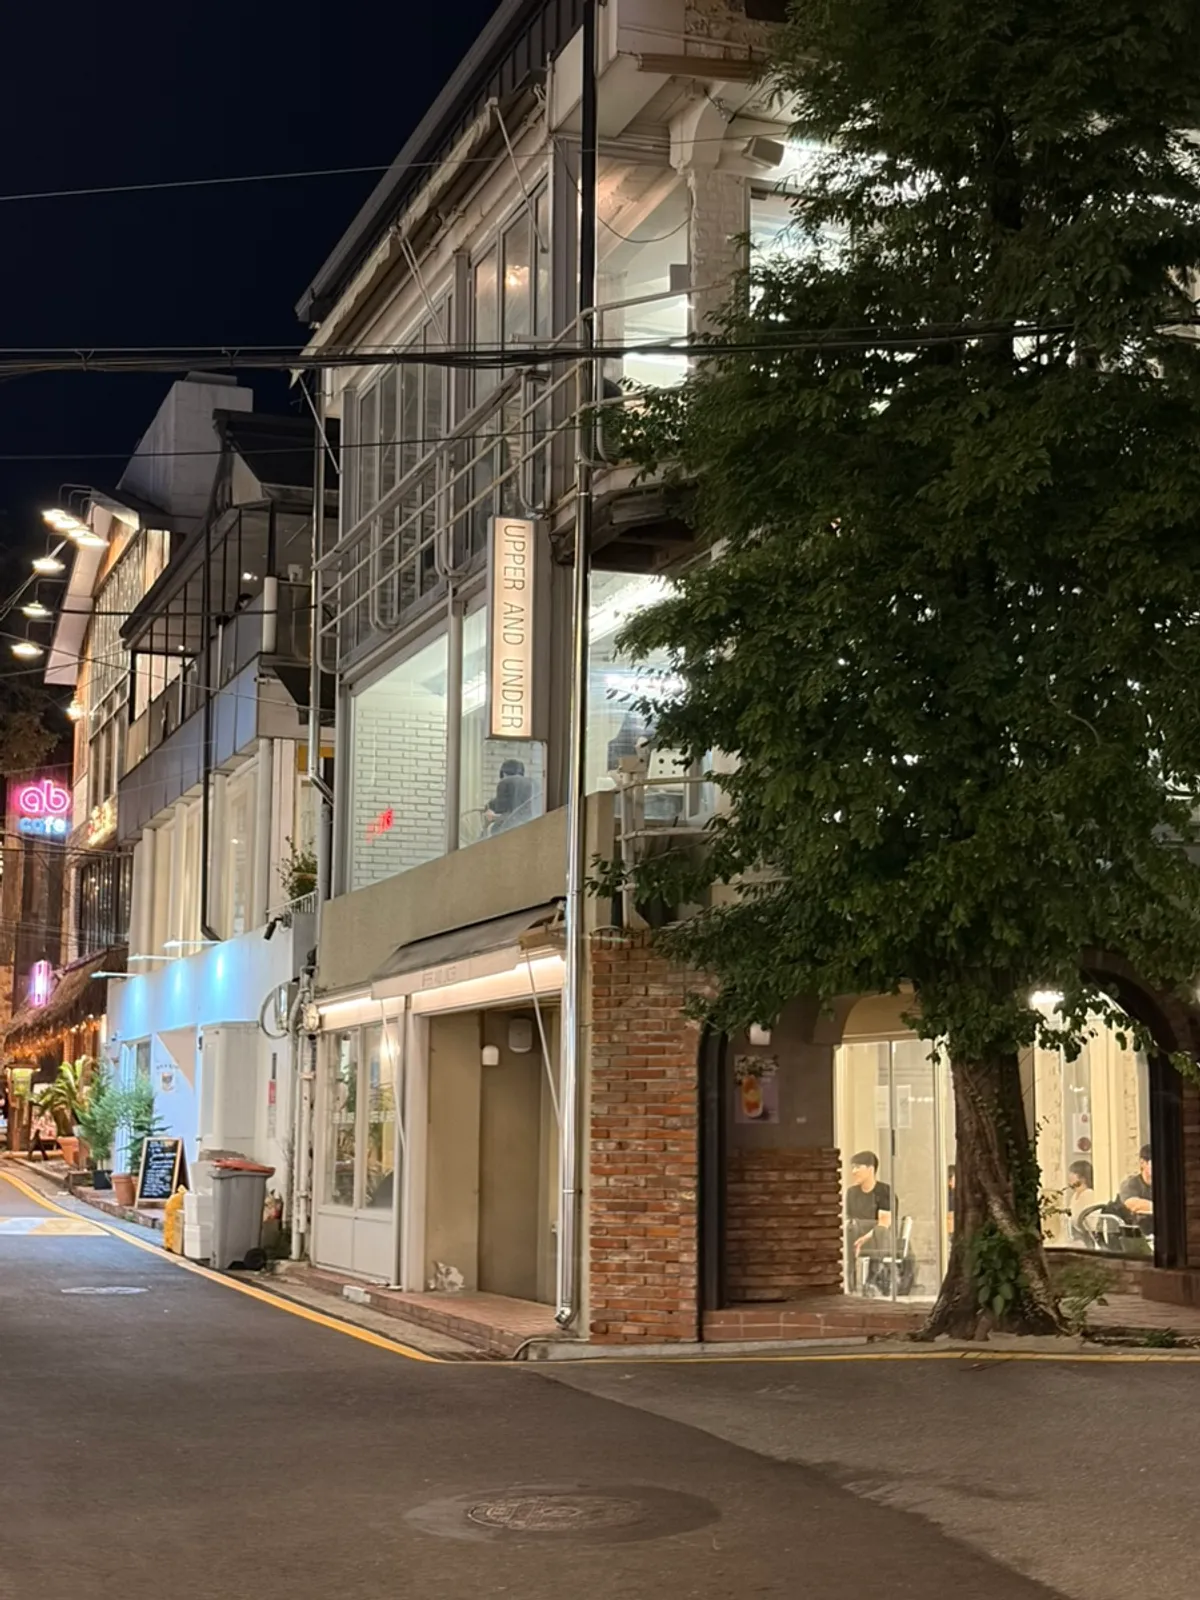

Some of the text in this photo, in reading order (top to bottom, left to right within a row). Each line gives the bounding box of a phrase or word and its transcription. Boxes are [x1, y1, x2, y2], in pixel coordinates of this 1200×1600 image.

[501, 524, 526, 729] UPPER AND UNDER
[20, 779, 70, 814] ab
[18, 816, 67, 834] cafe
